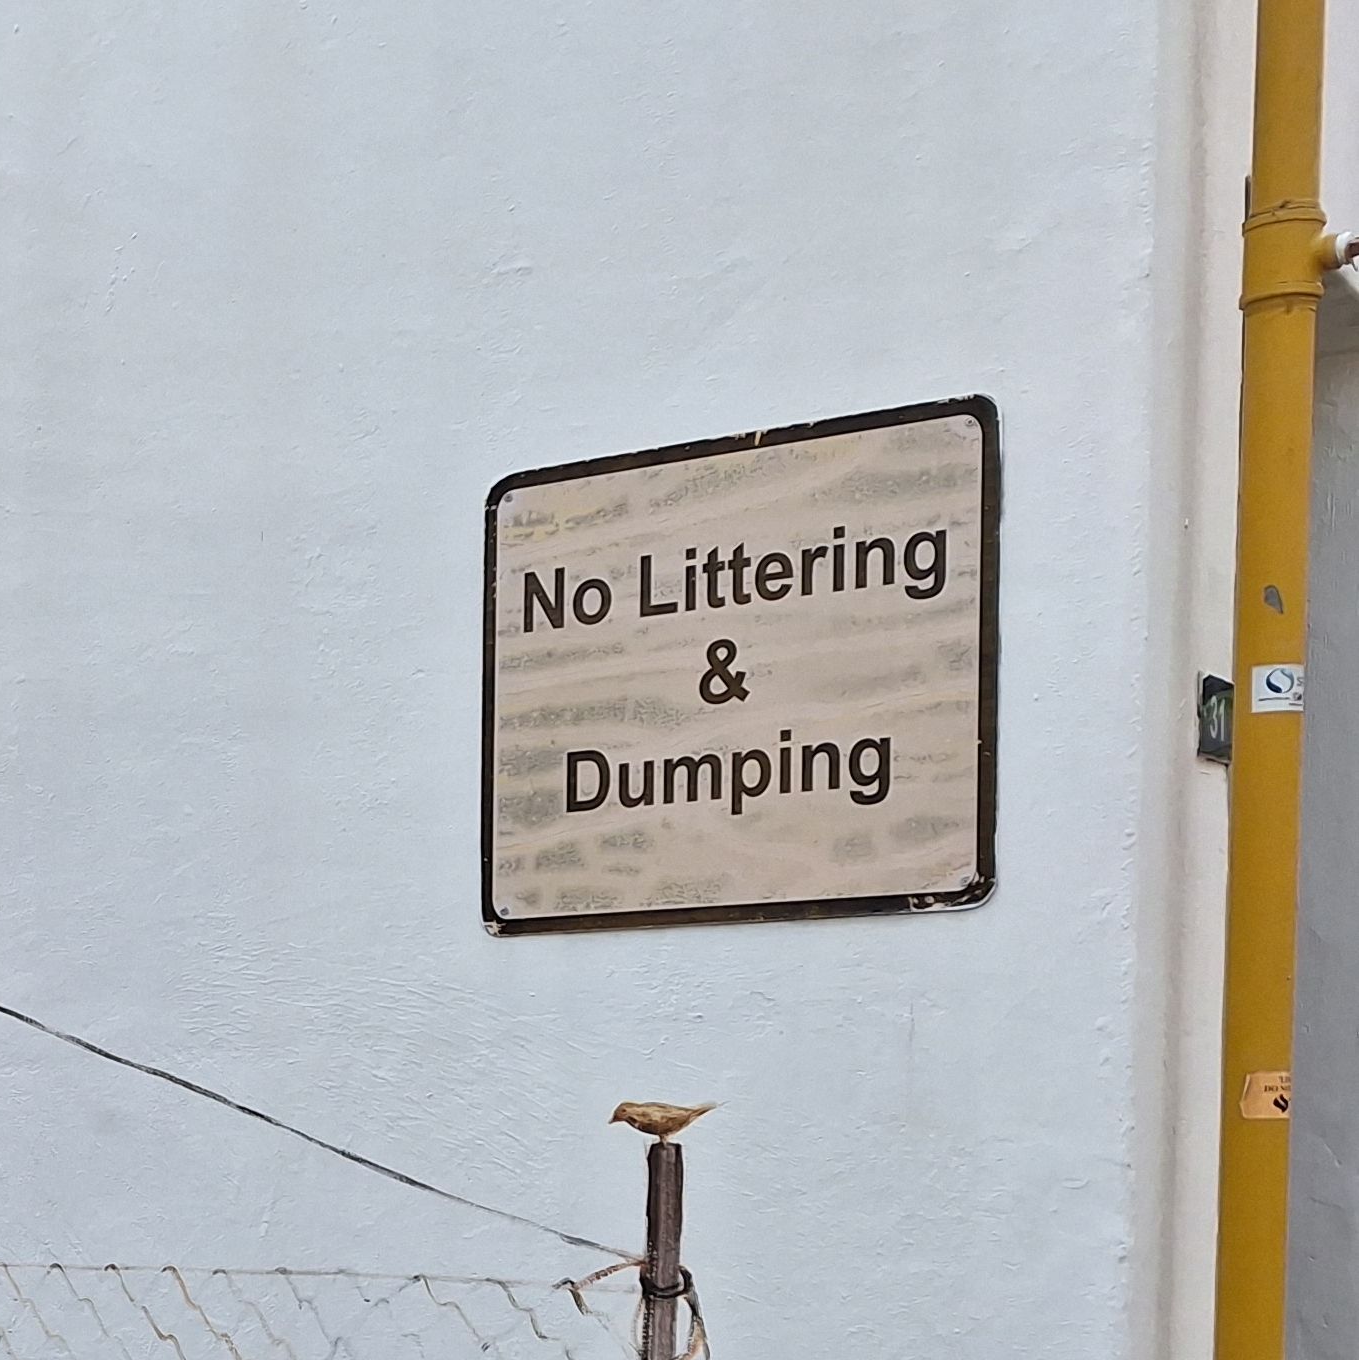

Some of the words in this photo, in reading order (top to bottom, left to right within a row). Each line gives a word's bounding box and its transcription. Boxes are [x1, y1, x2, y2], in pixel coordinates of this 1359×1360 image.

[522, 564, 613, 634] No
[638, 525, 948, 619] Littering
[698, 637, 751, 705] &
[565, 728, 892, 816] Dumping
